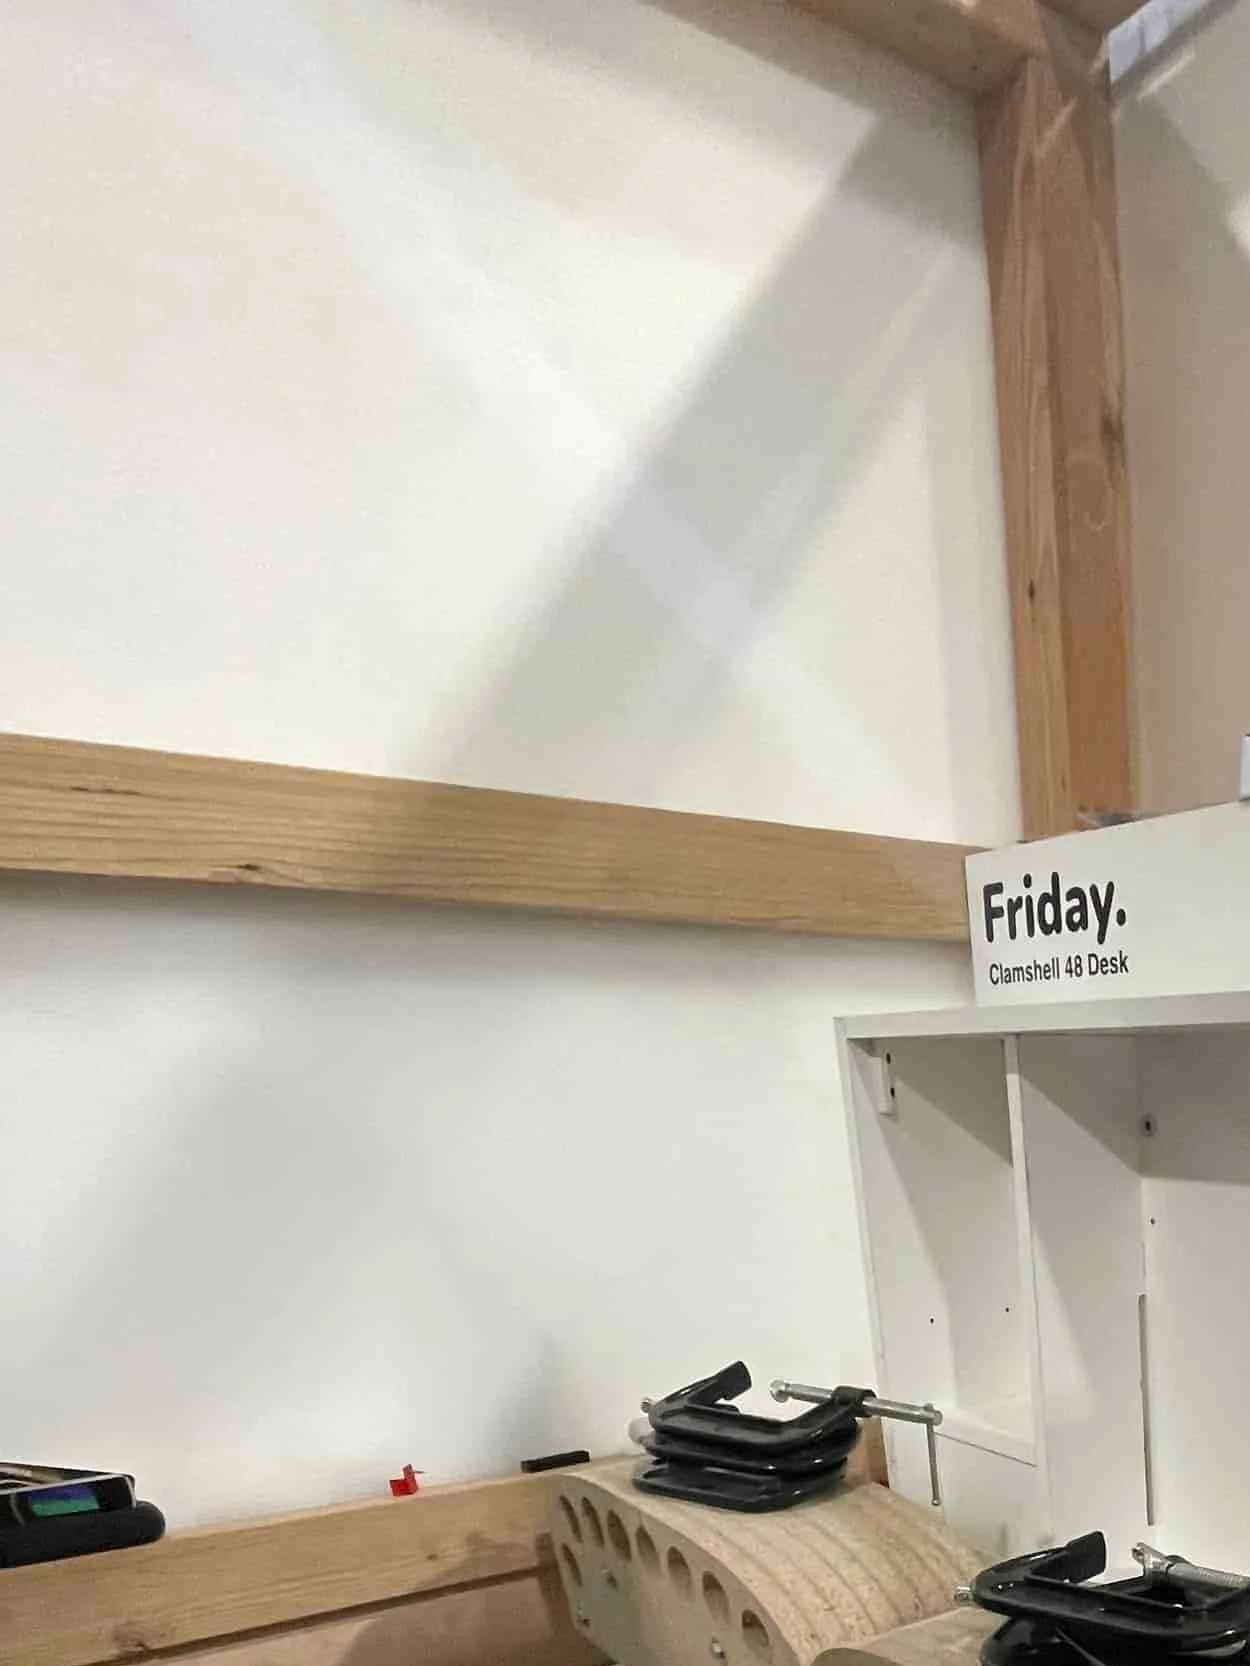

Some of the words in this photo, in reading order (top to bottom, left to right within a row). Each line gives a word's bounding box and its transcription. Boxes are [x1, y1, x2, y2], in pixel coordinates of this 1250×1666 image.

[983, 871, 1127, 945] Friday.
[989, 957, 1060, 985] Clamshell
[1065, 954, 1083, 978] 48
[1088, 950, 1129, 977] Desk
